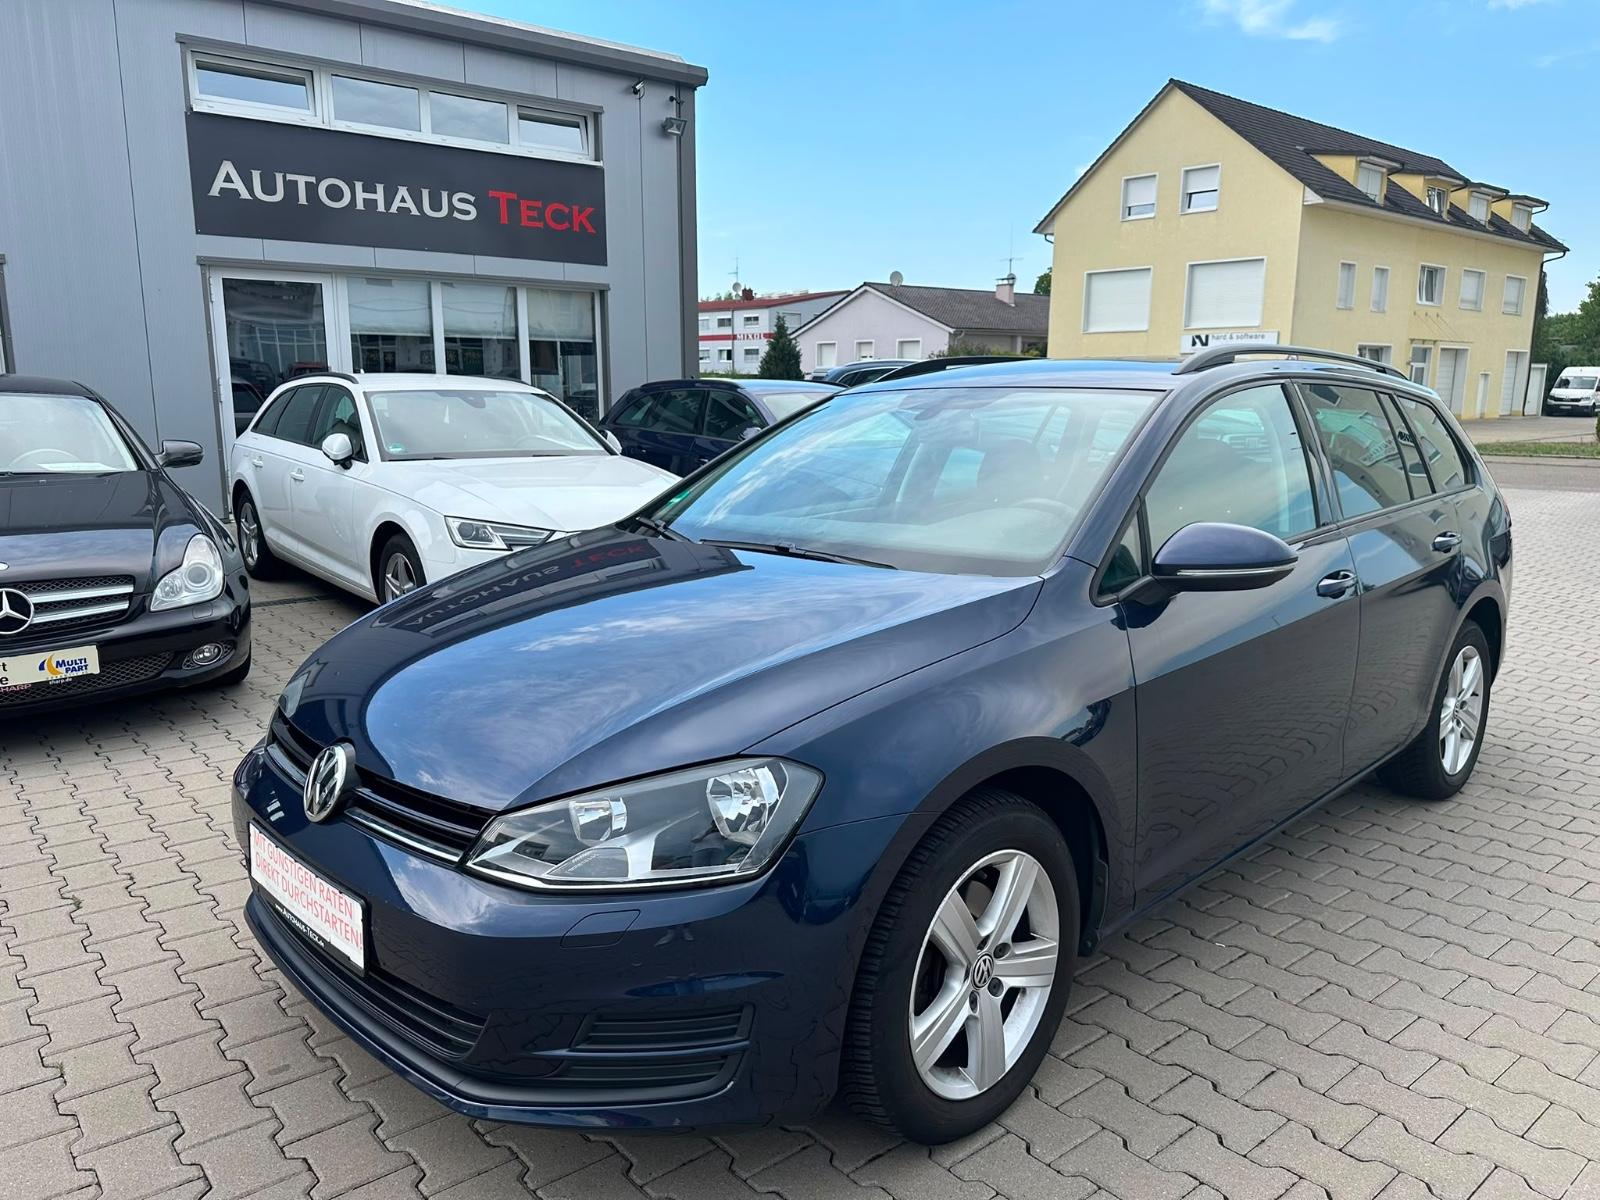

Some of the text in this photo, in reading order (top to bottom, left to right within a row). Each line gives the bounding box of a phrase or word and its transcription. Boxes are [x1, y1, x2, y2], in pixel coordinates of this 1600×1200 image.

[208, 160, 597, 235] AUTOHAUS TECK
[1236, 332, 1265, 340] software
[65, 664, 88, 674] PART
[256, 851, 363, 950] DIREKT DURCHSTARTEN!
[319, 882, 353, 920] RATEN
